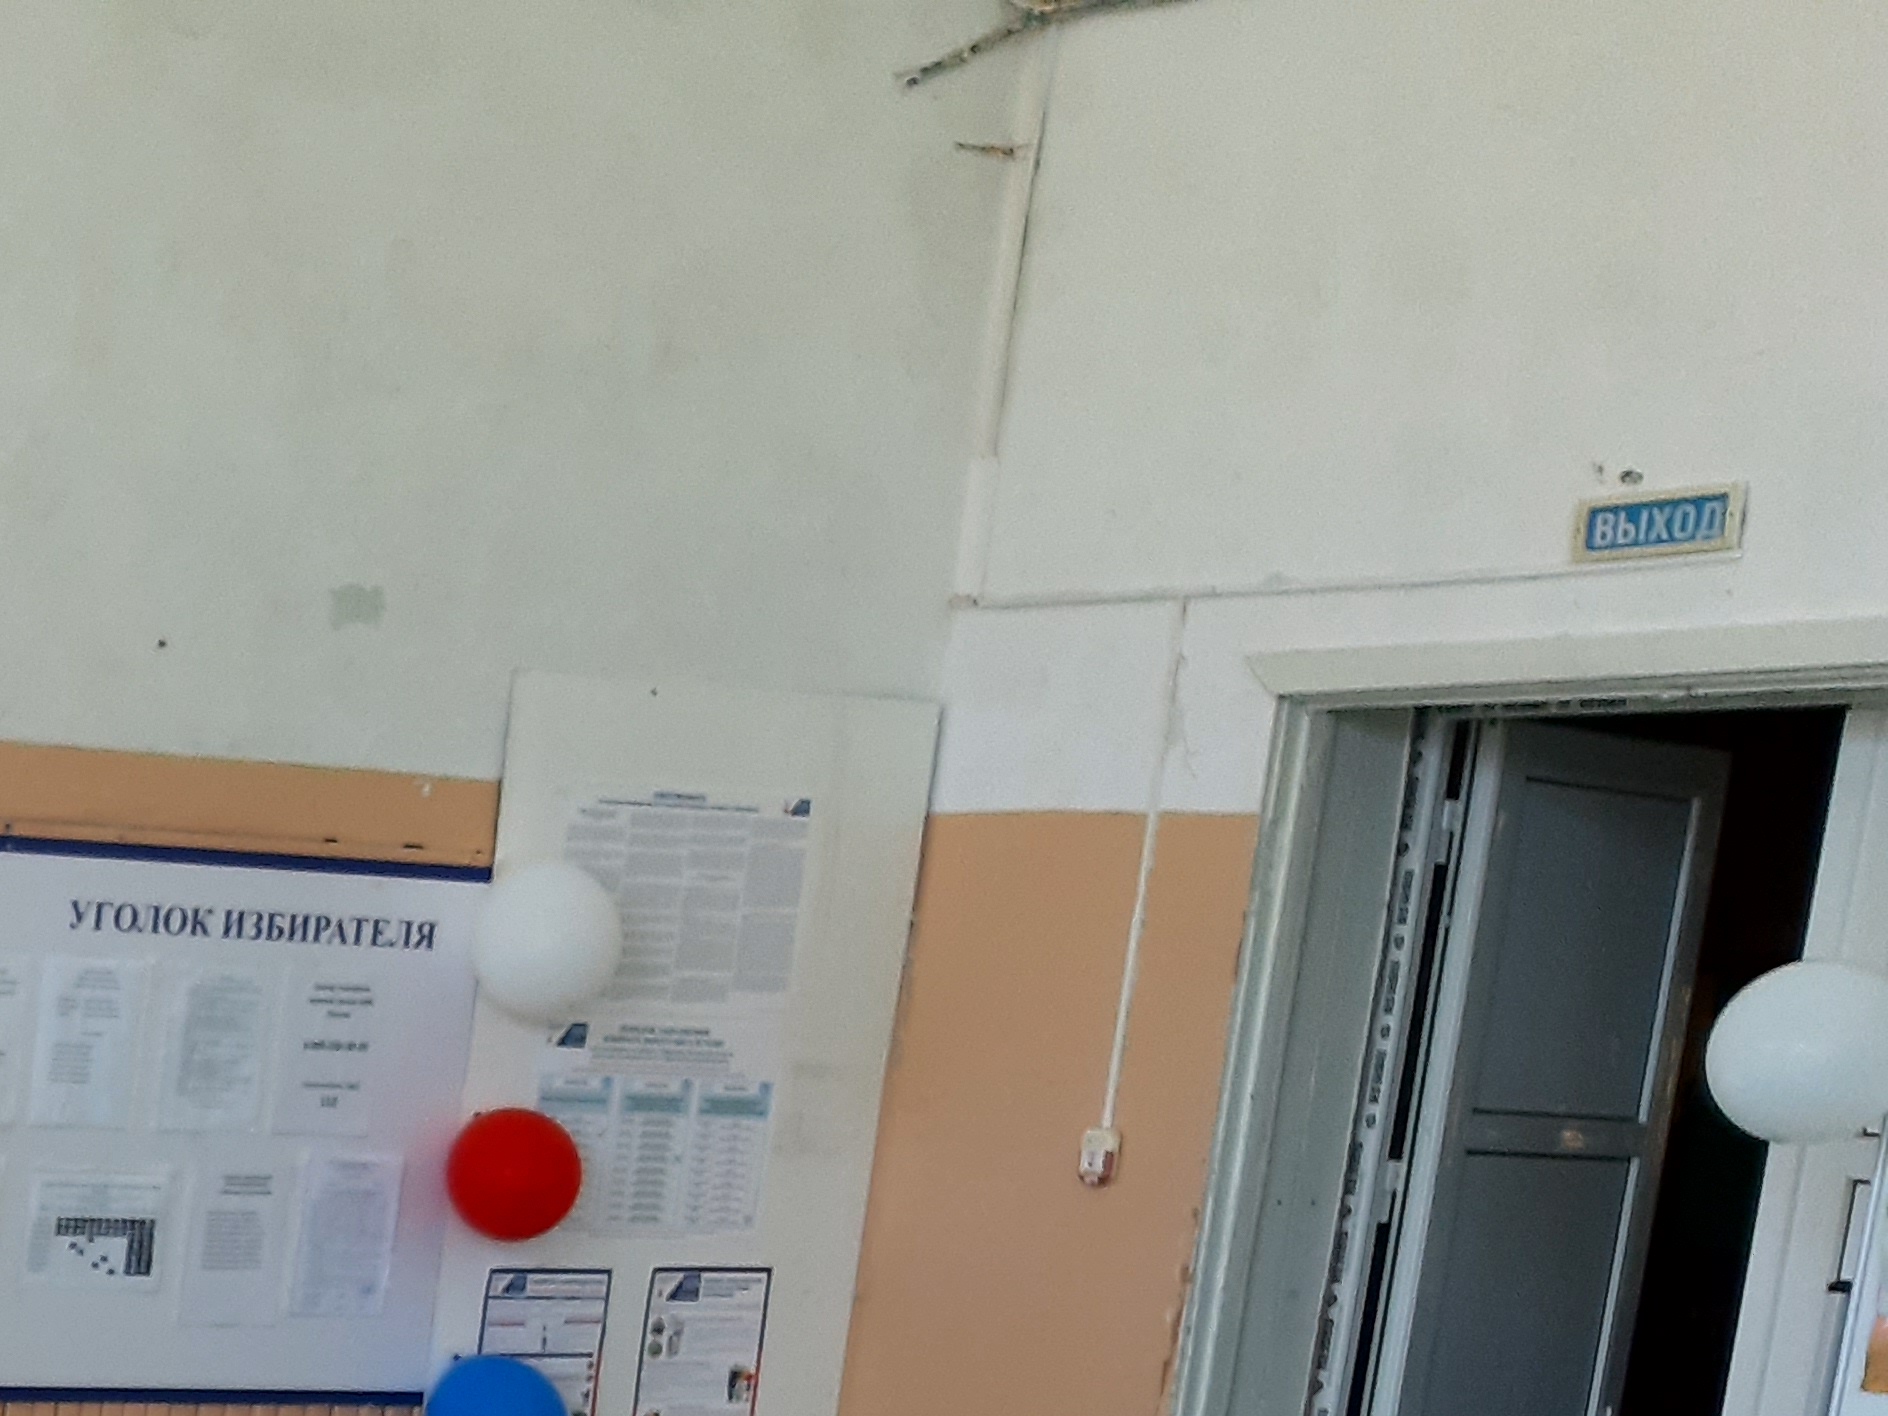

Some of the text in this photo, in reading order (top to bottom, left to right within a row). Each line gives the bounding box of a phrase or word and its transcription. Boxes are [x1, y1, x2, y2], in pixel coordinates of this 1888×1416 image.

[1594, 500, 1725, 547] ВЫХОД
[68, 898, 439, 951] УГОЛОК ИЗБИРАТЕЛЯ
